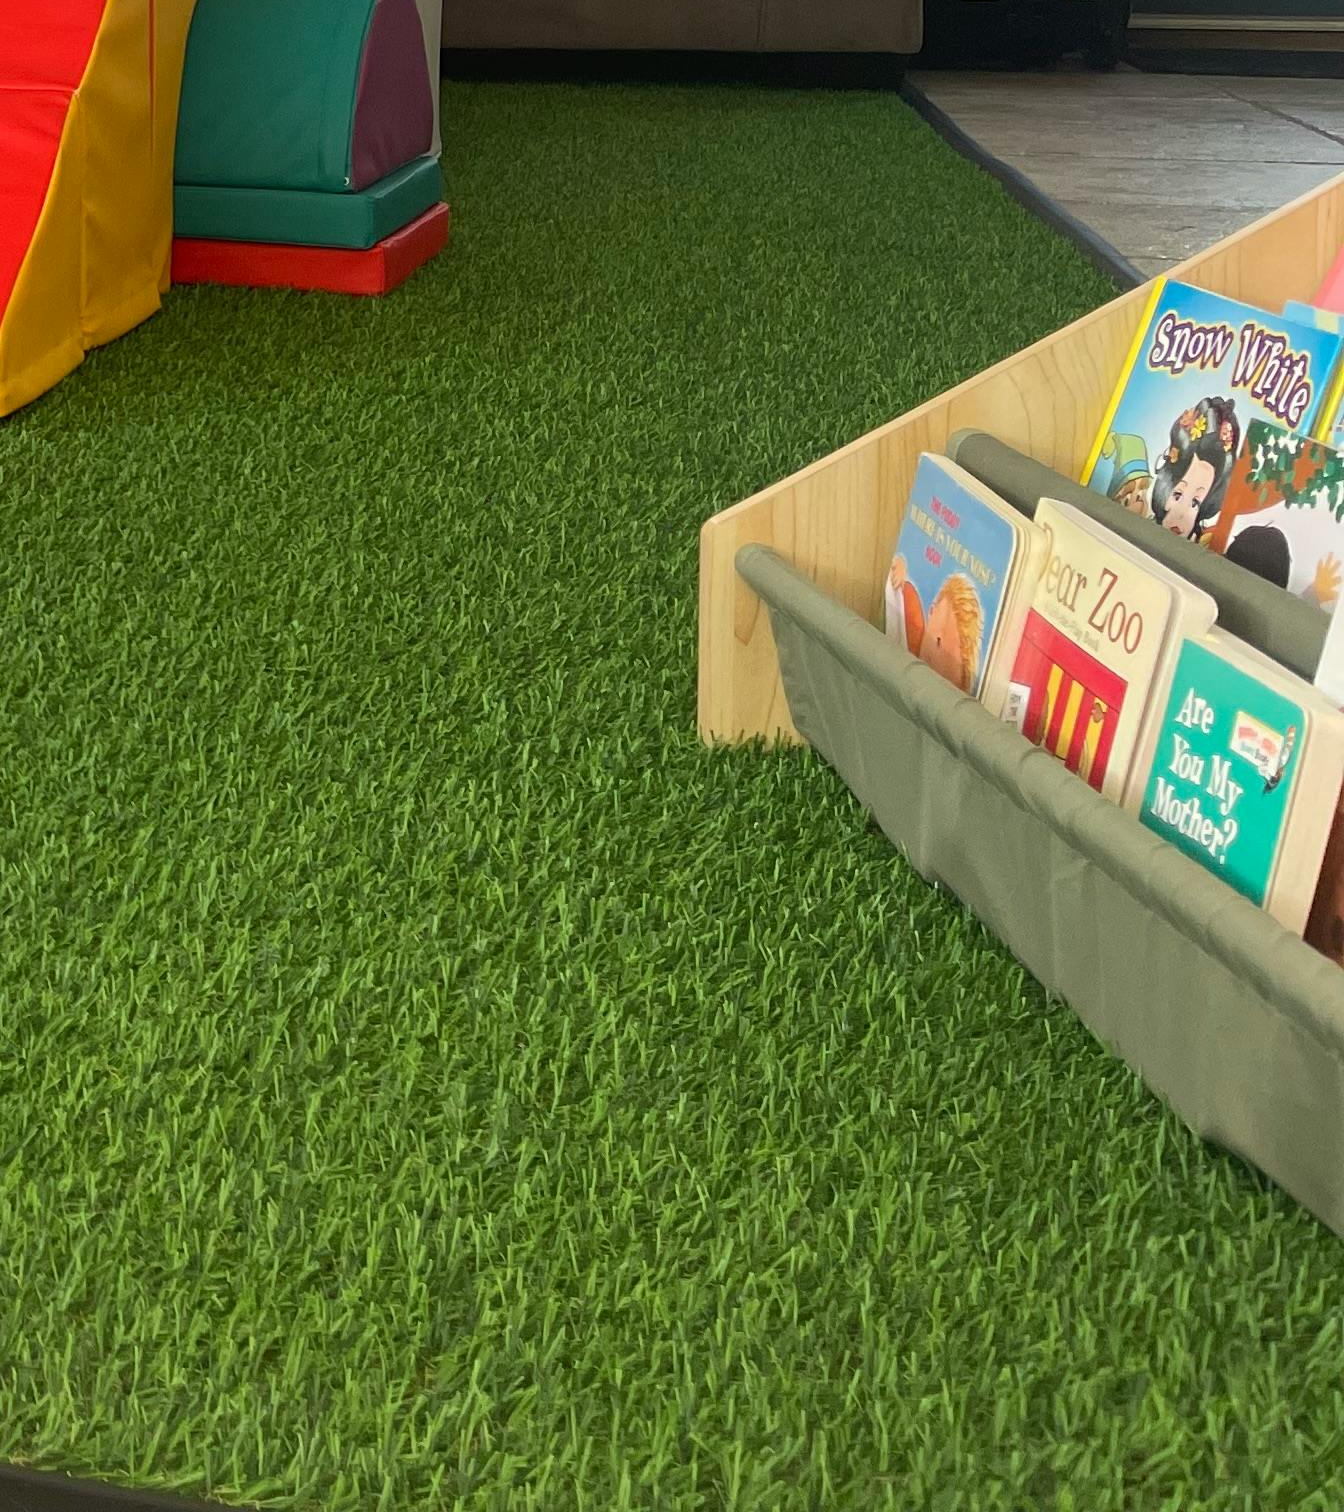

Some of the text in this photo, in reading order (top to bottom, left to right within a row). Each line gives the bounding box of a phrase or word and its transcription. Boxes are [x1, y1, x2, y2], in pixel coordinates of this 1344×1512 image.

[1150, 314, 1311, 427] Snow White
[1088, 567, 1144, 655] Zoo
[1175, 687, 1215, 734] Are
[1168, 733, 1205, 786] You
[1206, 754, 1244, 816] My
[1151, 776, 1238, 865] Mother?
